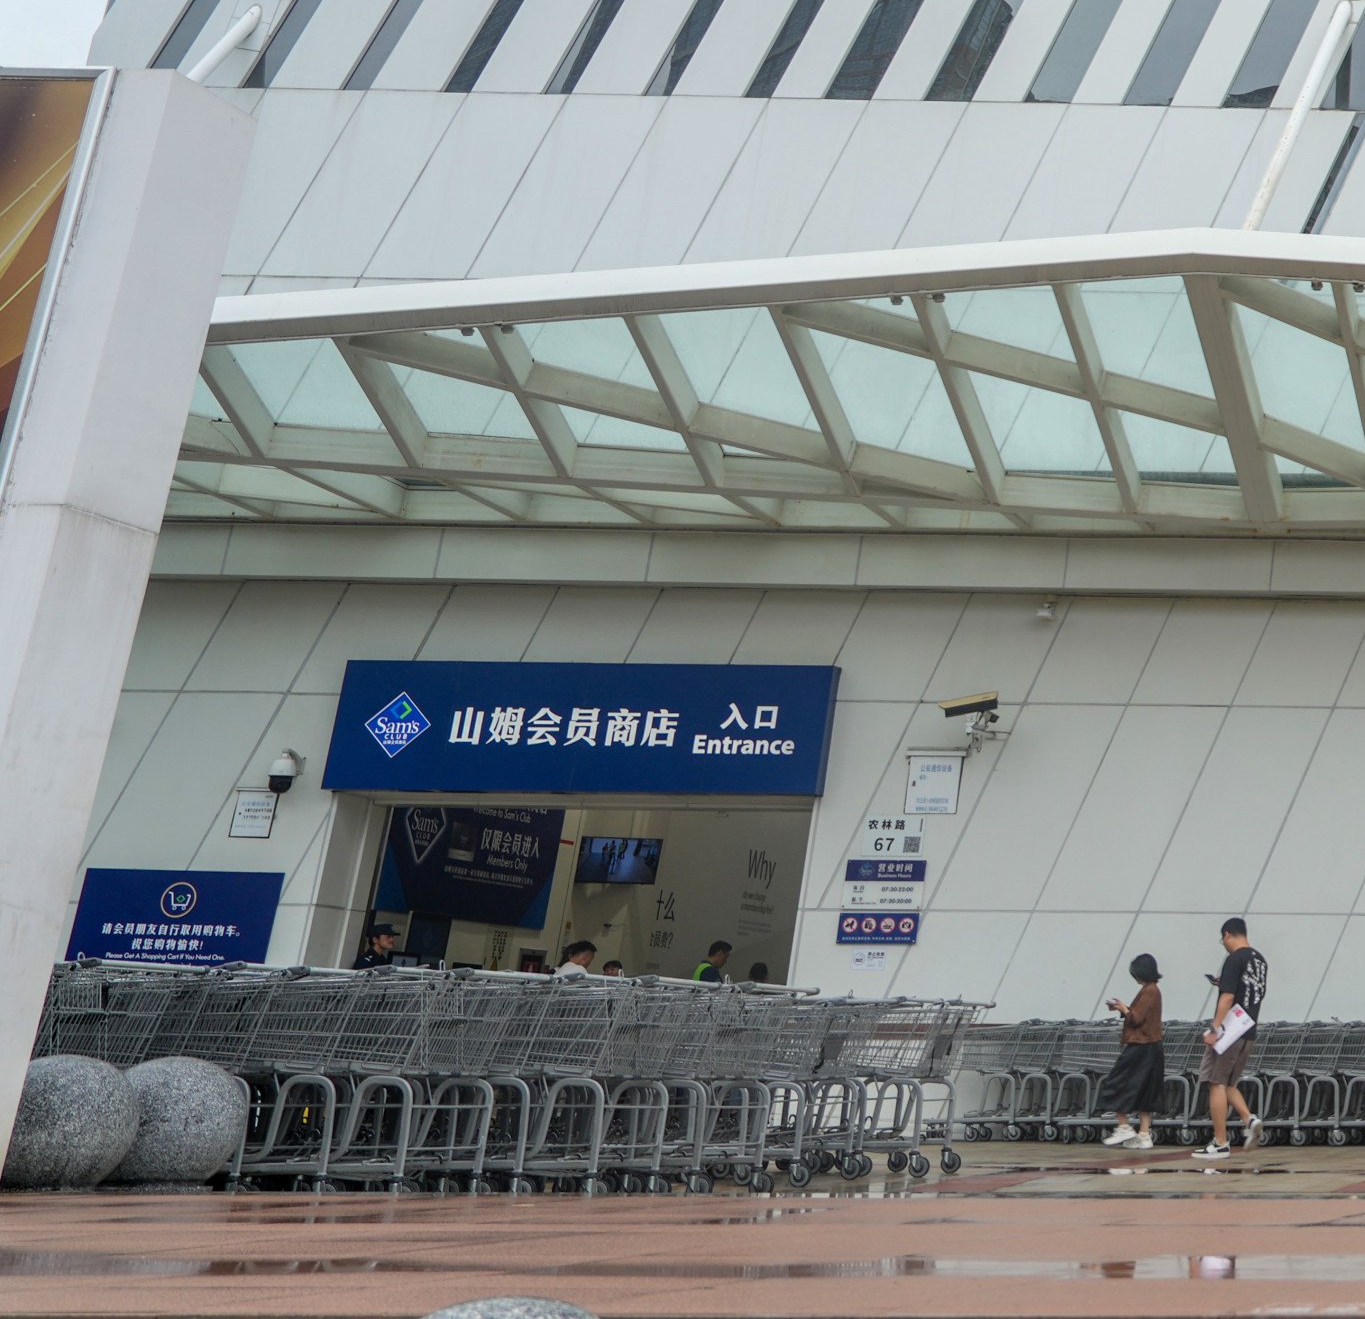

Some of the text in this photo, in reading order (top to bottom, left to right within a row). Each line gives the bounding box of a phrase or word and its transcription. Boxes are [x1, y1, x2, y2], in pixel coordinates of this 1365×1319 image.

[375, 716, 420, 734] Sam's
[719, 702, 779, 730] 入口
[448, 706, 680, 747] 山姆会员商店
[692, 734, 795, 755] Entrance
[411, 808, 439, 834] Sam's
[868, 819, 906, 830] 农林路
[481, 827, 540, 859] 仅限会员进入
[874, 837, 895, 852] 67
[486, 854, 528, 873] Members Only
[748, 848, 776, 890] Why
[878, 863, 914, 873] 营业时间
[141, 953, 166, 961] Shopping
